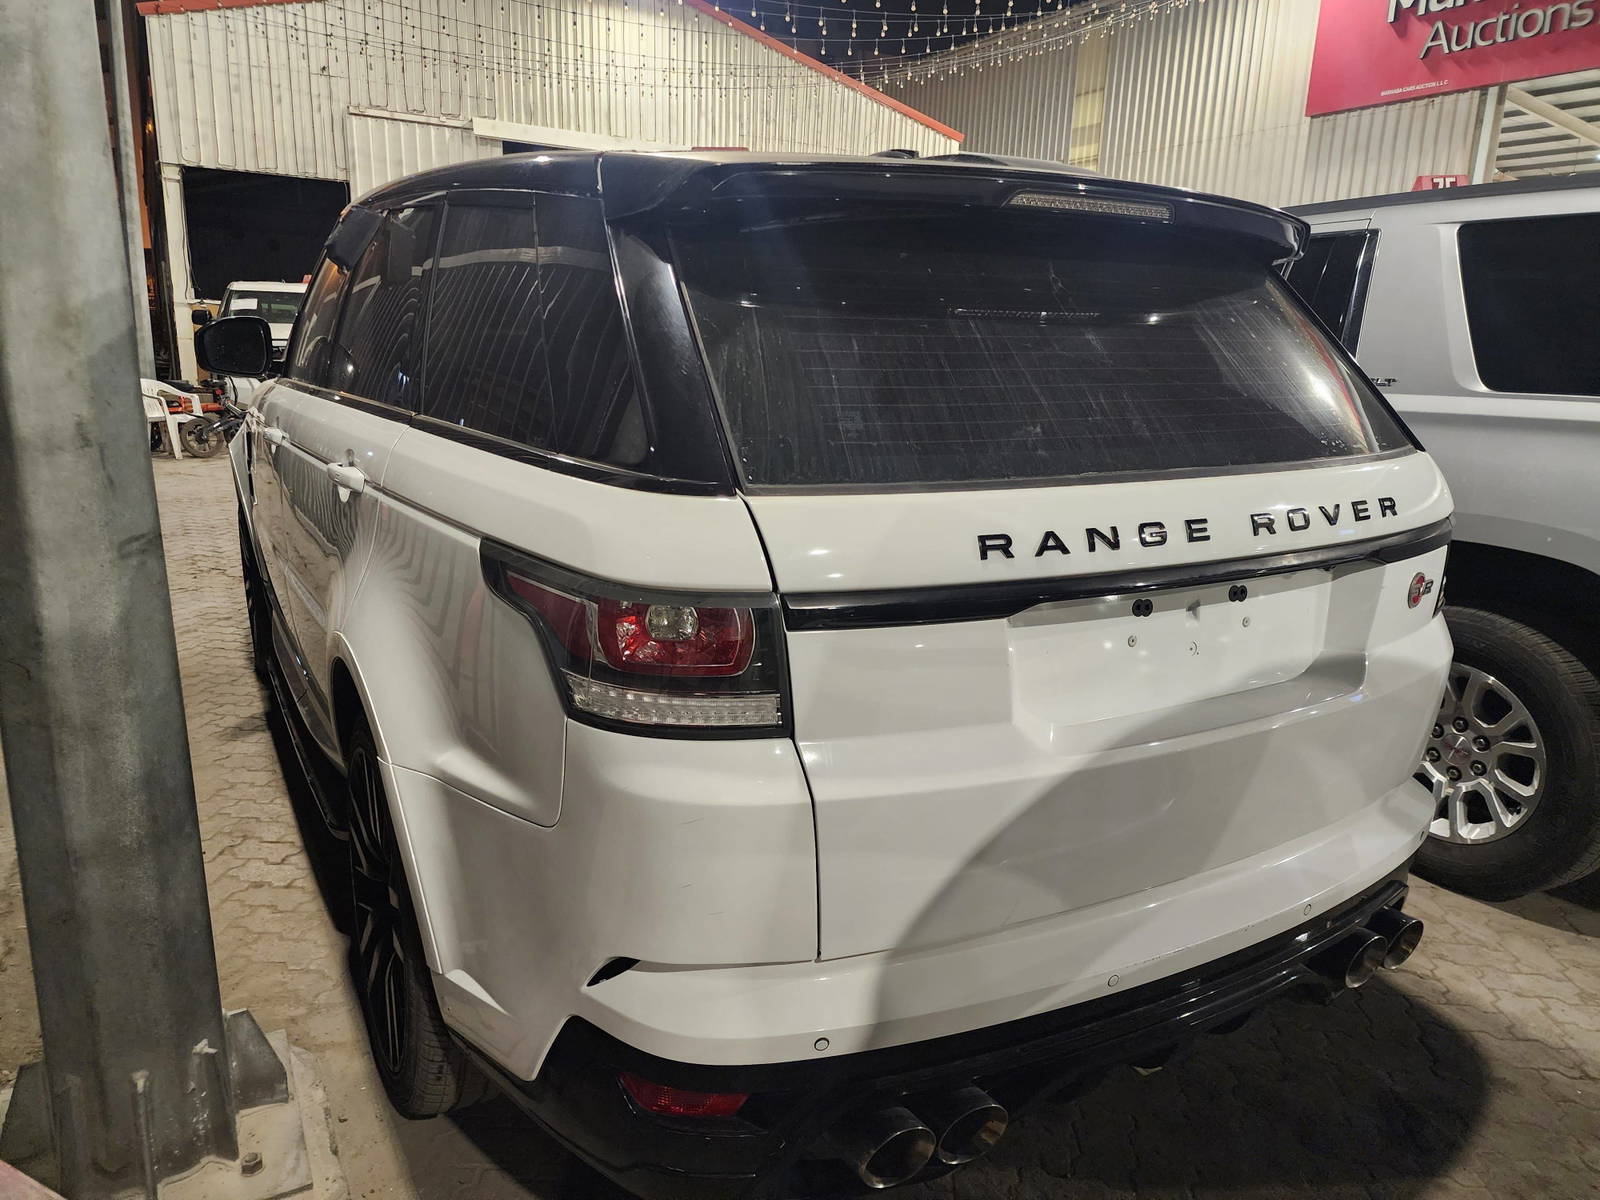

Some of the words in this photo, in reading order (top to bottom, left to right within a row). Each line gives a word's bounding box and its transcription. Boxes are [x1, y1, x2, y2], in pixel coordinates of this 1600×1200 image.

[1419, 0, 1595, 60] Auctions
[977, 518, 1211, 561] RANGE
[1250, 496, 1399, 537] ROVER
